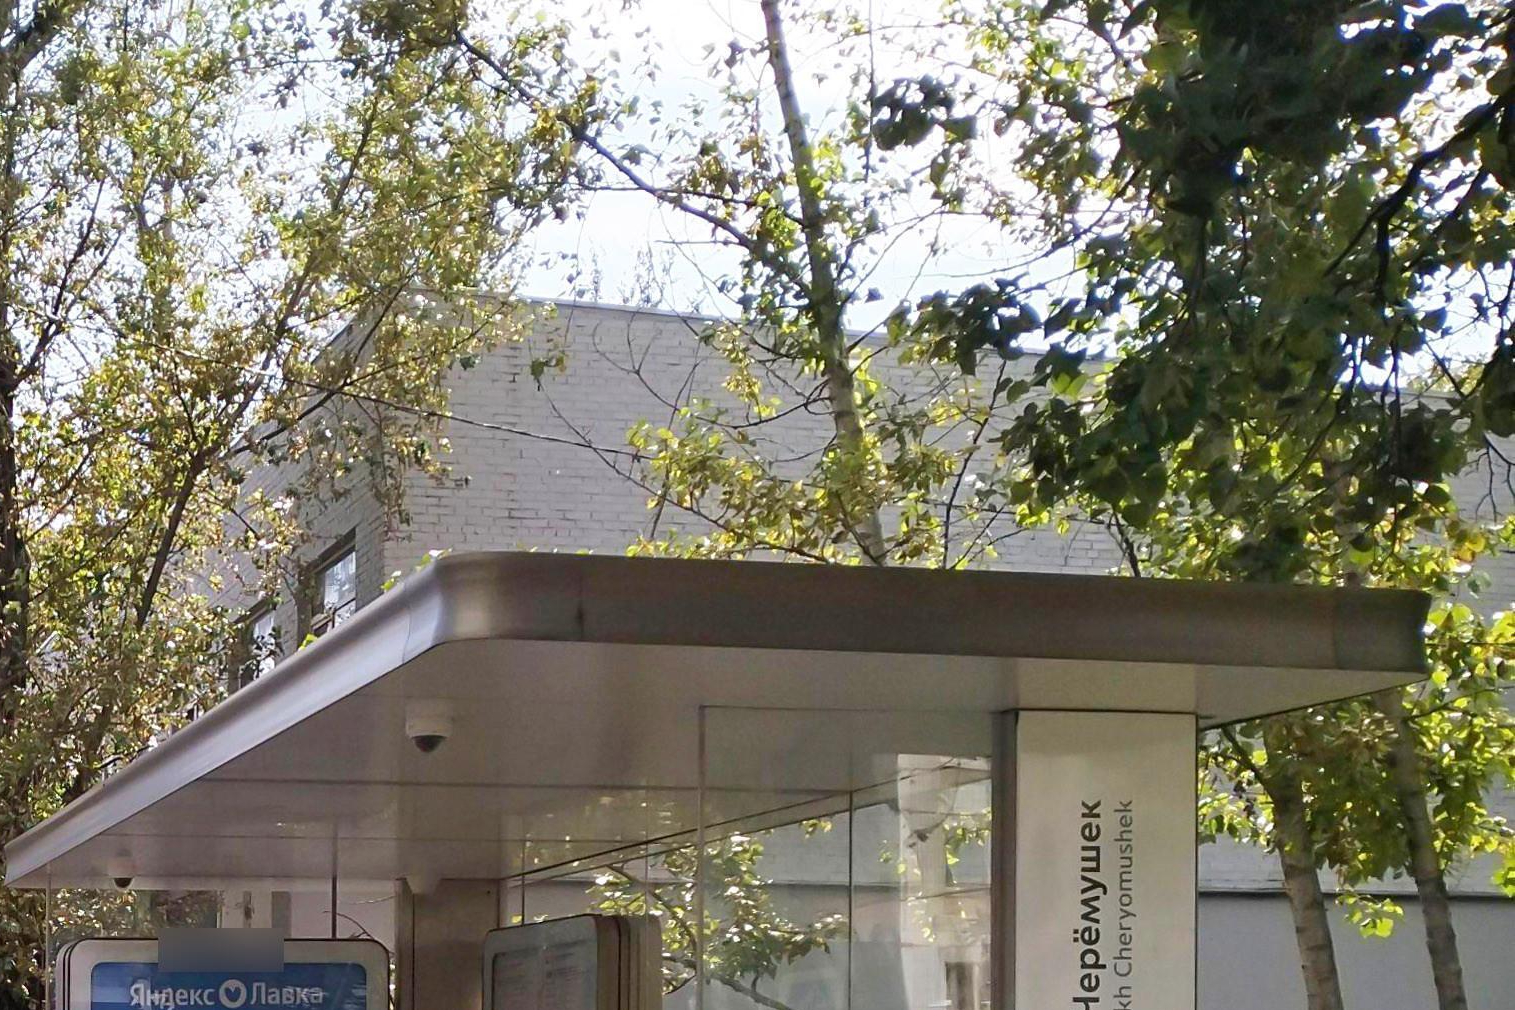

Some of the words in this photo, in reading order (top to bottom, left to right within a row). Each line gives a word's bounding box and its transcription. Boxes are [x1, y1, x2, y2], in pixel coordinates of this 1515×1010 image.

[1113, 800, 1137, 977] Cheryomushek
[129, 981, 216, 1008] Яндекс
[250, 981, 325, 1005] Лавка
